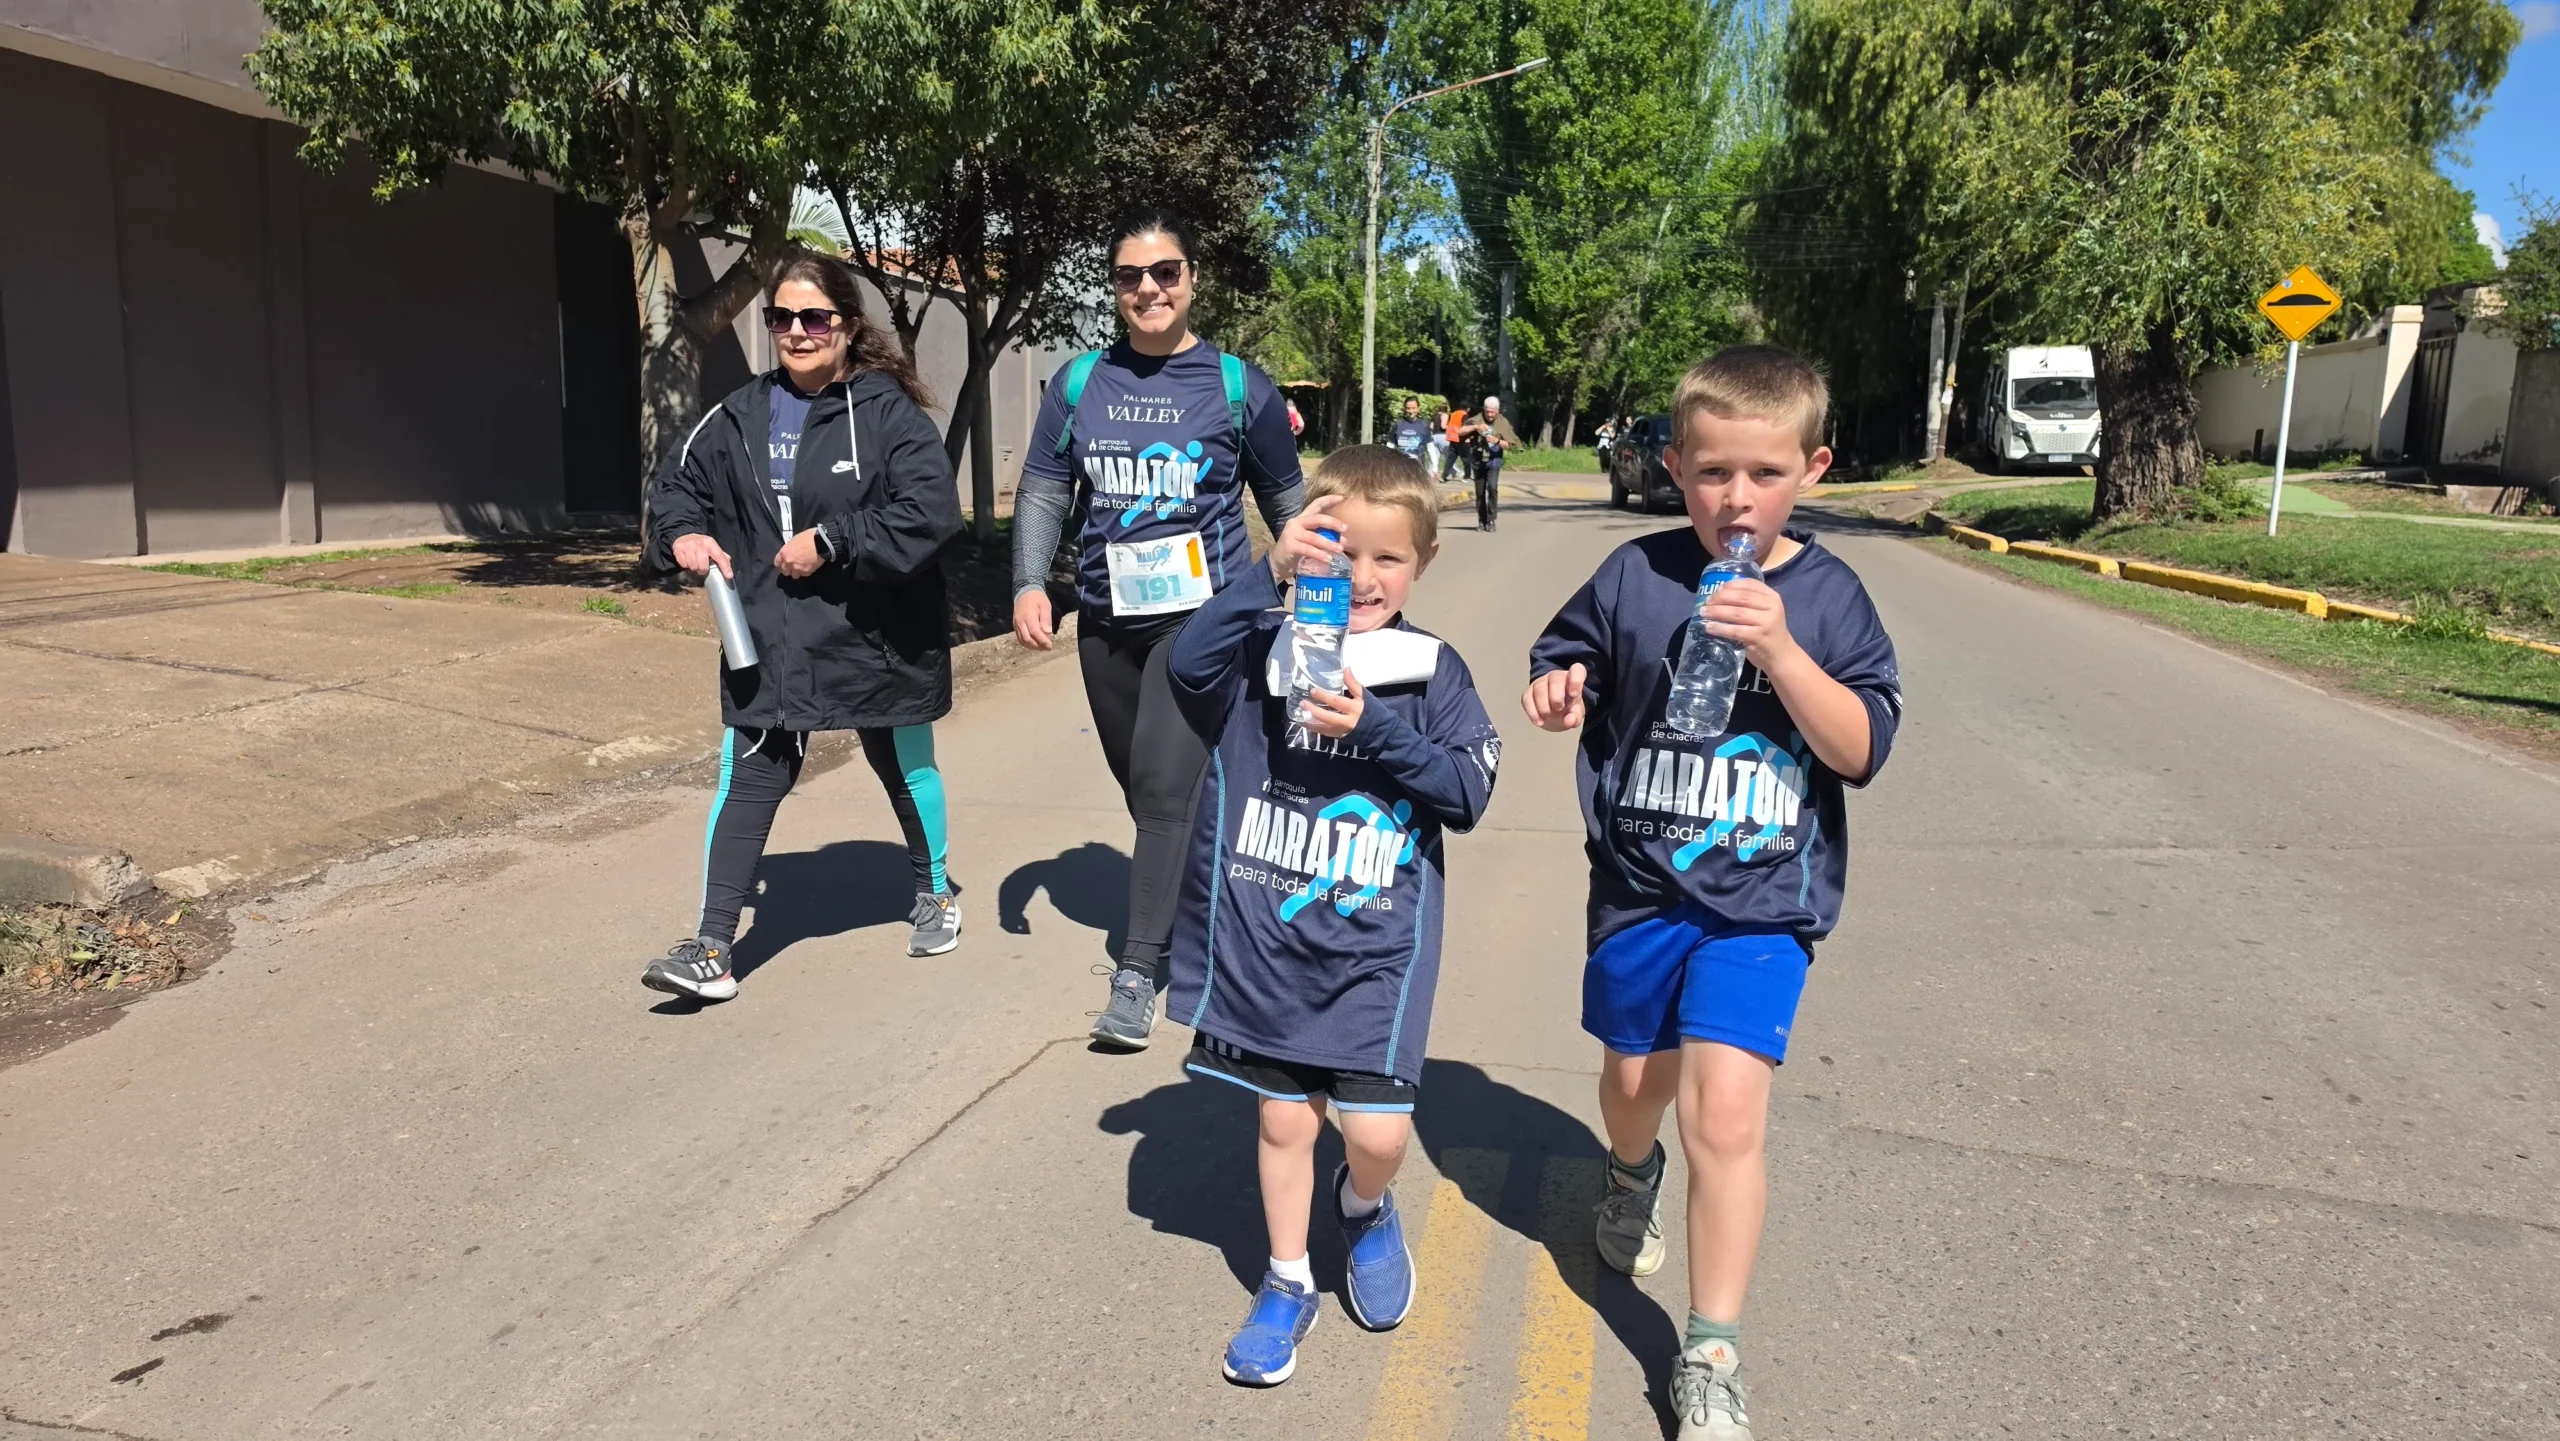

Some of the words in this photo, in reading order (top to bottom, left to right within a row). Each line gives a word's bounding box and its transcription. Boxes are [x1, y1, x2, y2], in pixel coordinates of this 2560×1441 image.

[1123, 394, 1172, 405] PALMARES
[1107, 405, 1186, 424] VALLEY
[1083, 451, 1199, 499] MARATÓN
[1092, 496, 1110, 508] para
[1112, 498, 1139, 510] toda
[1142, 500, 1152, 511] la
[1154, 500, 1197, 513] familia
[1135, 574, 1182, 602] 191
[1651, 729, 1665, 739] de
[1667, 731, 1705, 743] chacras
[1272, 787, 1281, 797] de
[1280, 789, 1309, 805] chacras
[1274, 779, 1306, 795] parroquia
[1619, 746, 1803, 826] MARATÓN
[1236, 796, 1406, 888] MARATÓN
[1659, 820, 1706, 844] toda
[1712, 830, 1729, 847] la
[1734, 829, 1796, 851] familia
[1229, 862, 1268, 886] para
[1271, 871, 1310, 896] toda
[1314, 882, 1329, 902] la
[1332, 886, 1393, 911] familia
